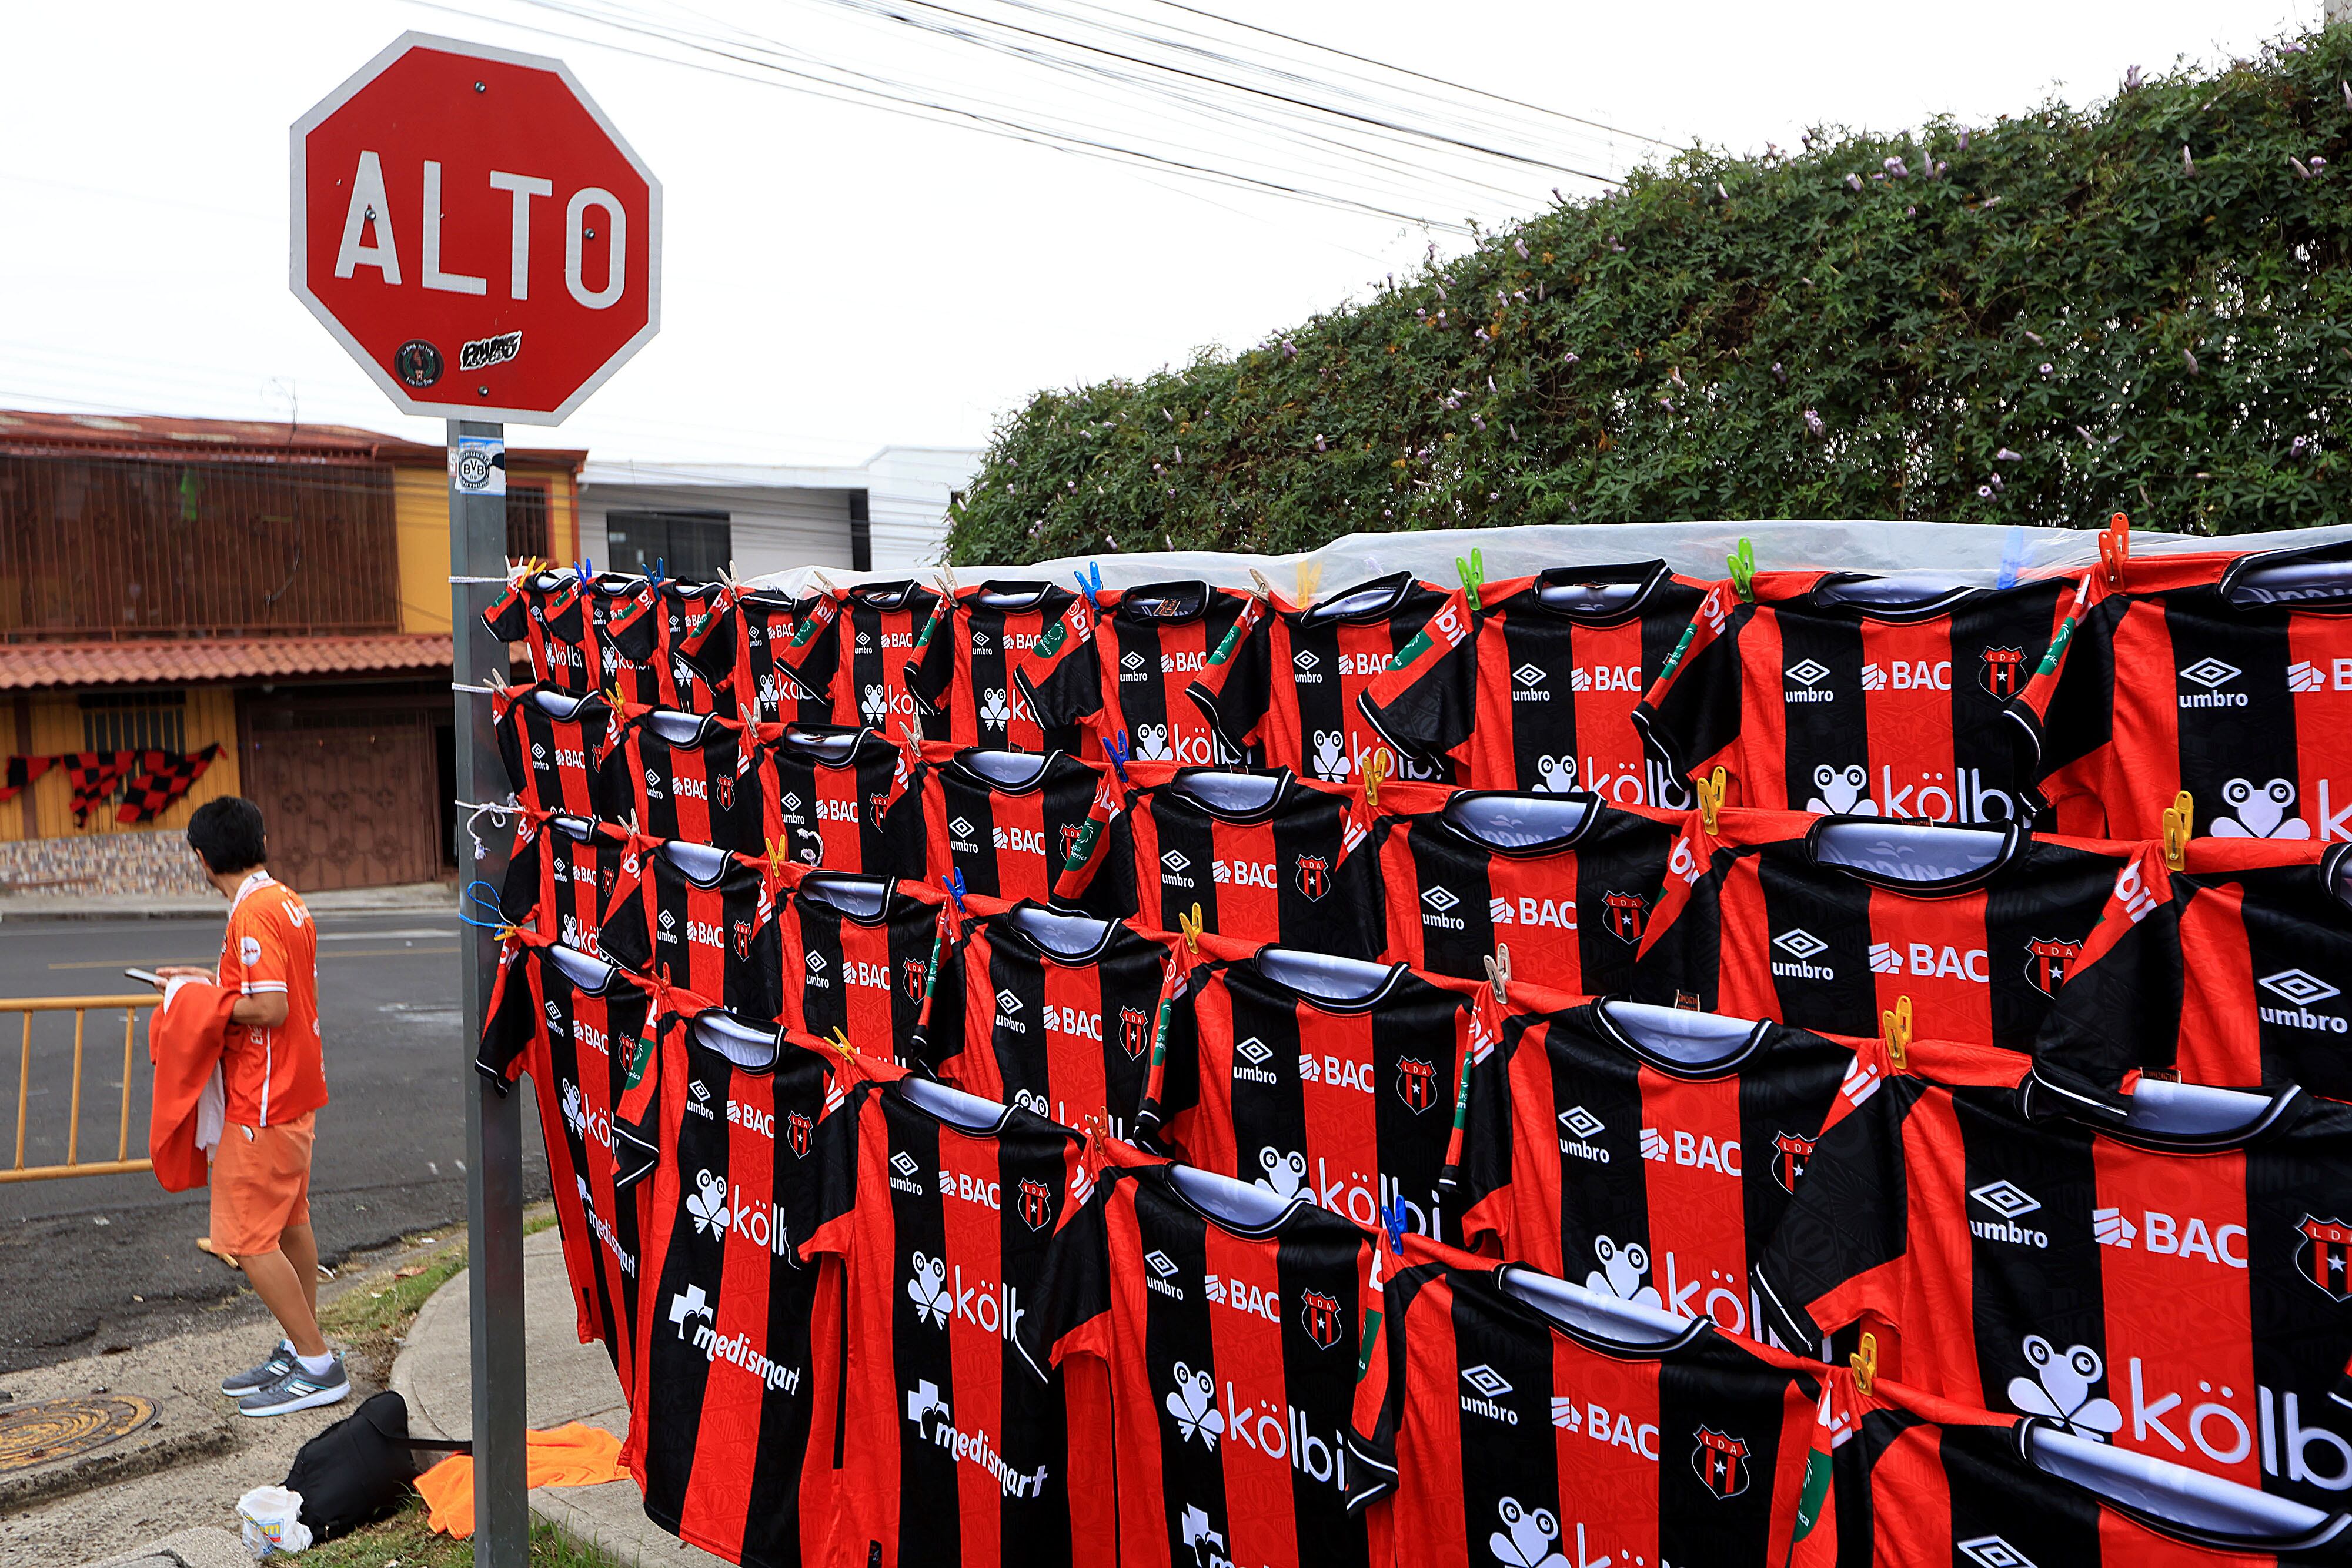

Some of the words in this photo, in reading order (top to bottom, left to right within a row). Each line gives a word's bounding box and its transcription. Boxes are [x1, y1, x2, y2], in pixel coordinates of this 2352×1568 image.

[334, 149, 627, 310] ALTO
[463, 459, 485, 475] BVB
[776, 622, 794, 638] BAC
[891, 633, 913, 648] BAC
[749, 638, 763, 647] umbro
[854, 645, 873, 654] umbro
[972, 646, 993, 656] umbro
[555, 643, 583, 668] kölbi
[1175, 651, 1207, 672] BAC
[1356, 653, 1394, 675] BAC
[1120, 670, 1148, 683] umbro
[1294, 671, 1322, 683] umbro
[1595, 666, 1642, 692] BAC
[1892, 661, 1952, 691] BAC
[1512, 687, 1551, 701] umbro
[1785, 687, 1834, 703] umbro
[2179, 689, 2249, 708] umbro
[532, 760, 549, 771] umbro
[564, 748, 586, 770] BAC
[683, 777, 708, 800] BAC
[720, 778, 731, 787] LDA
[1587, 756, 1692, 810] kölb
[646, 787, 663, 800] umbro
[874, 798, 887, 806] LDA
[781, 812, 805, 825] umbro
[829, 799, 859, 823] BAC
[950, 839, 978, 854] umbro
[1010, 827, 1046, 855] BAC
[581, 865, 597, 887] BAC
[1234, 860, 1277, 889] BAC
[1302, 861, 1322, 870] LDA
[554, 874, 567, 883] umbro
[1162, 872, 1194, 888] umbro
[1611, 898, 1638, 907] LDA
[1422, 912, 1464, 930] umbro
[1519, 897, 1578, 930] BAC
[657, 930, 677, 945] umbro
[697, 925, 724, 948] BAC
[2037, 946, 2073, 957] LDA
[906, 964, 924, 973] LDA
[1772, 960, 1834, 981] umbro
[1909, 942, 1990, 983] BAC
[806, 974, 830, 989] umbro
[858, 961, 891, 991] BAC
[546, 1019, 564, 1037] umbro
[995, 1014, 1025, 1034] umbro
[1062, 1006, 1103, 1042] BAC
[1125, 1013, 1142, 1024] LDA
[2260, 1006, 2348, 1034] umbro
[584, 1028, 609, 1056] BAC
[1233, 1065, 1277, 1085] umbro
[1324, 1055, 1375, 1094] BAC
[1404, 1064, 1428, 1076] LDA
[686, 1101, 714, 1121] umbro
[743, 1103, 774, 1139] BAC
[792, 1119, 808, 1129] LDA
[1559, 1137, 1610, 1164] umbro
[1673, 1129, 1742, 1177] BAC
[890, 1176, 923, 1196] umbro
[959, 1172, 1001, 1211] BAC
[1025, 1185, 1044, 1197] LDA
[588, 1208, 636, 1279] medismart
[1970, 1220, 2049, 1249] umbro
[2144, 1210, 2249, 1268] BAC
[1147, 1276, 1184, 1301] umbro
[1230, 1278, 1281, 1323] BAC
[1308, 1297, 1331, 1311] LDA
[692, 1324, 800, 1396] medismart
[1461, 1396, 1518, 1425] umbro
[1588, 1402, 1659, 1462] BAC
[2130, 1356, 2352, 1492] kölb
[1227, 1380, 1345, 1492] kölbi
[1705, 1435, 1738, 1456] LDA
[934, 1419, 1048, 1498] medismart
